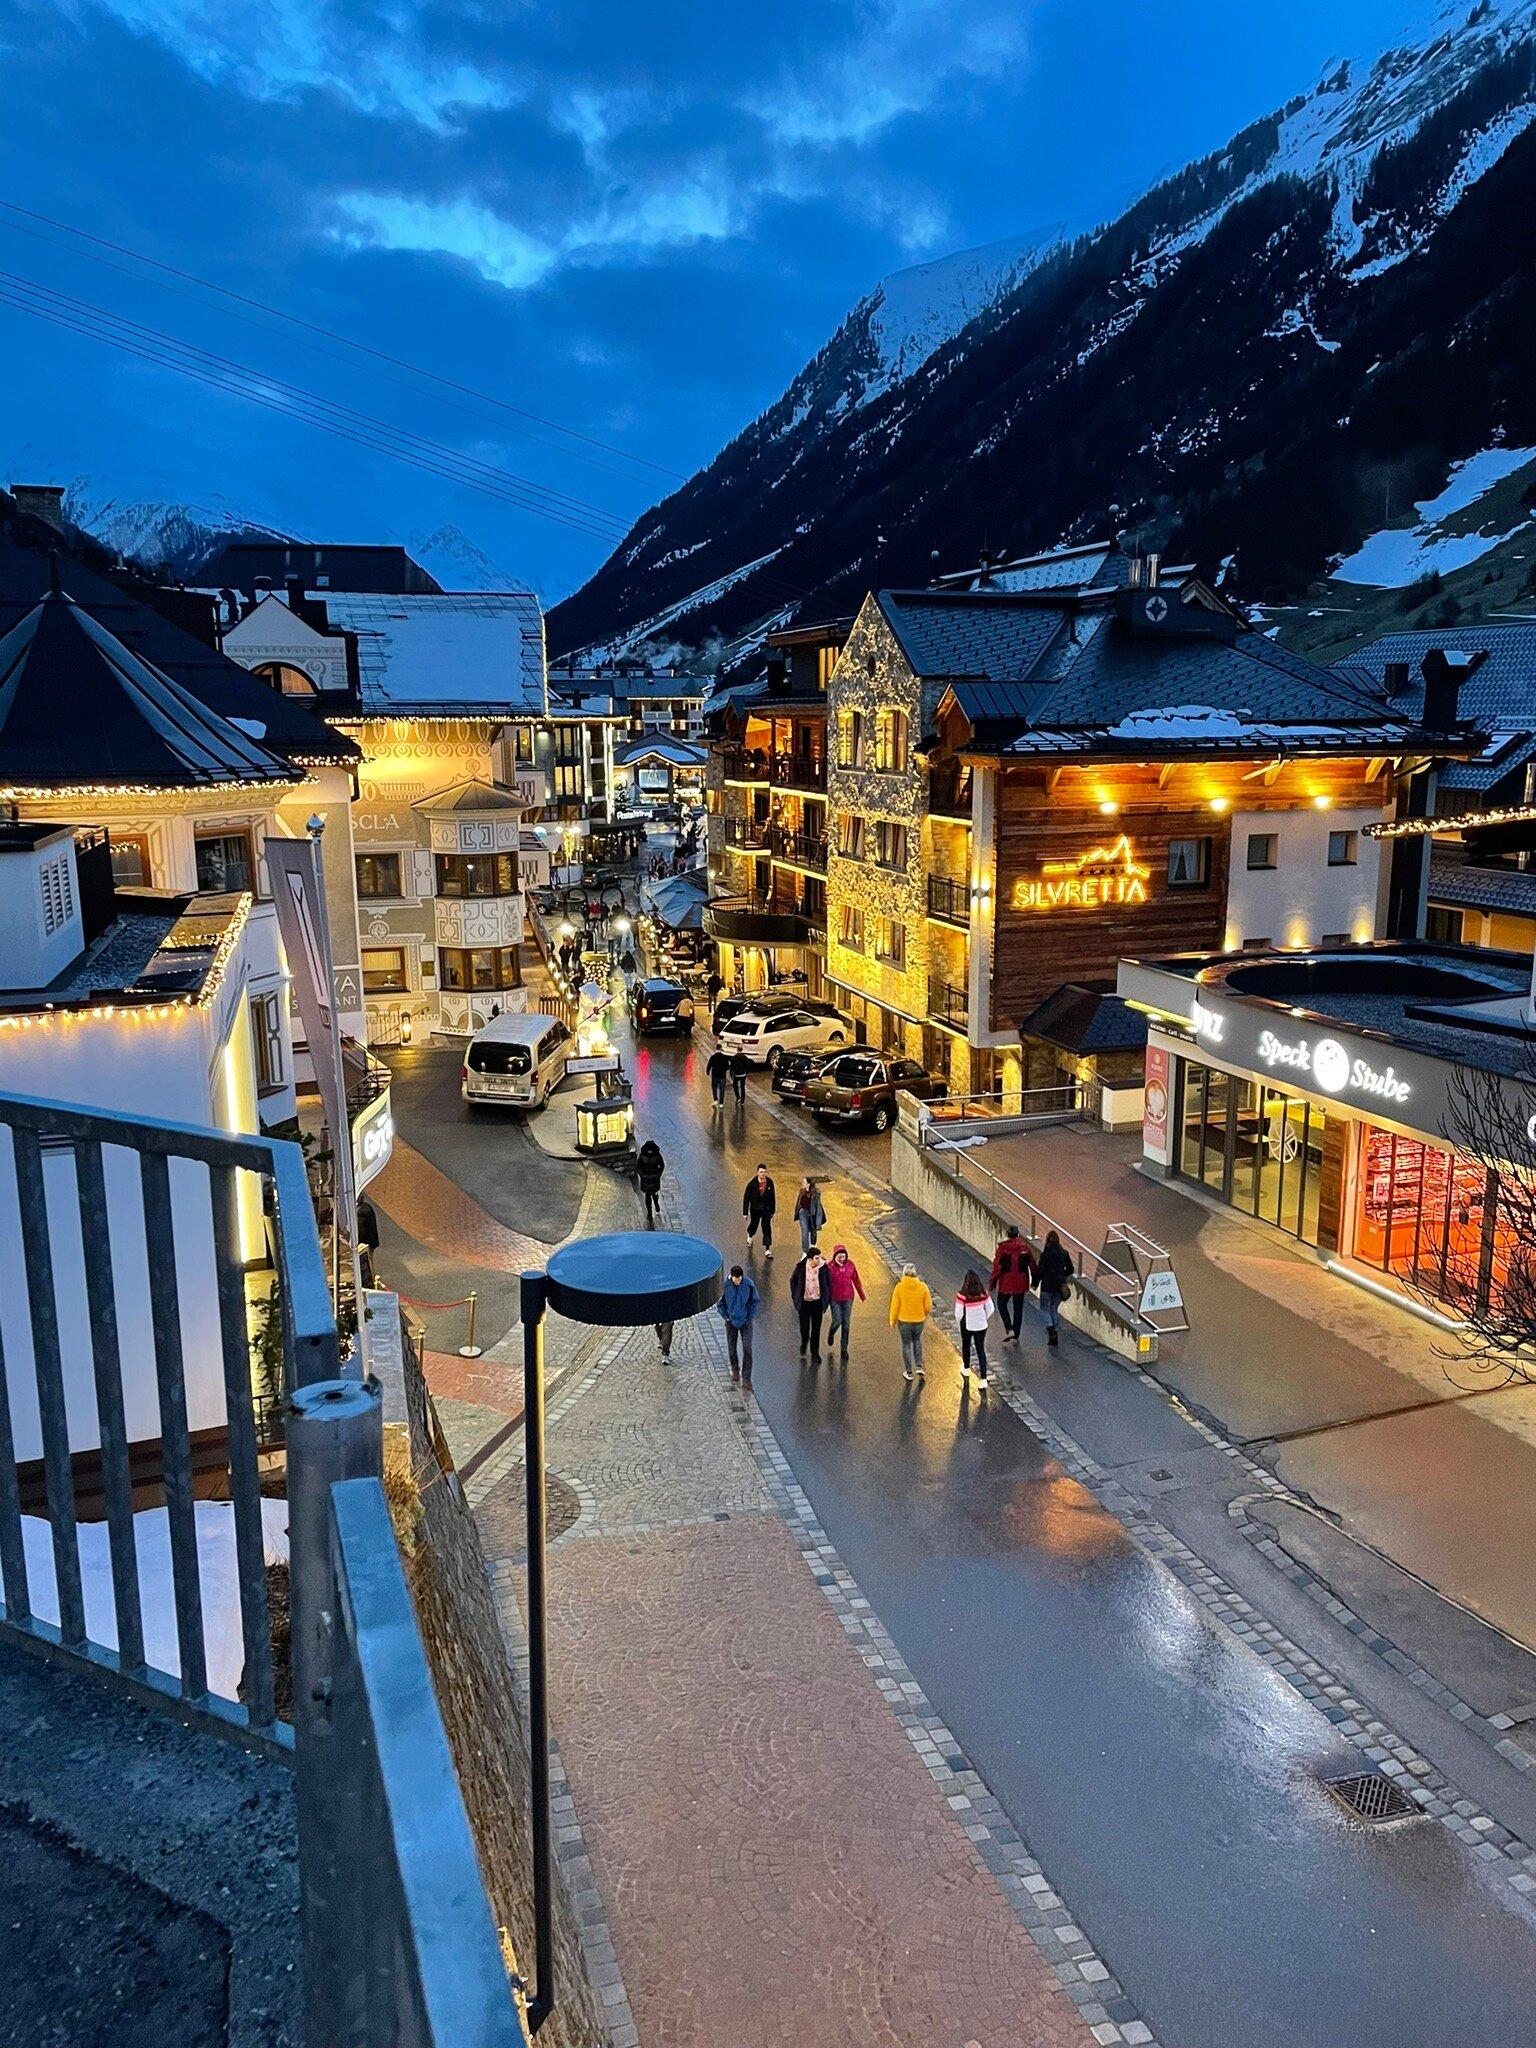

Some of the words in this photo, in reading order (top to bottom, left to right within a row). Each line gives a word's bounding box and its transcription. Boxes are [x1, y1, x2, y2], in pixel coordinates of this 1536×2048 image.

[1014, 875, 1147, 908] SILVRETTA
[1259, 1030, 1311, 1071] Speck
[1350, 1059, 1412, 1103] Stube
